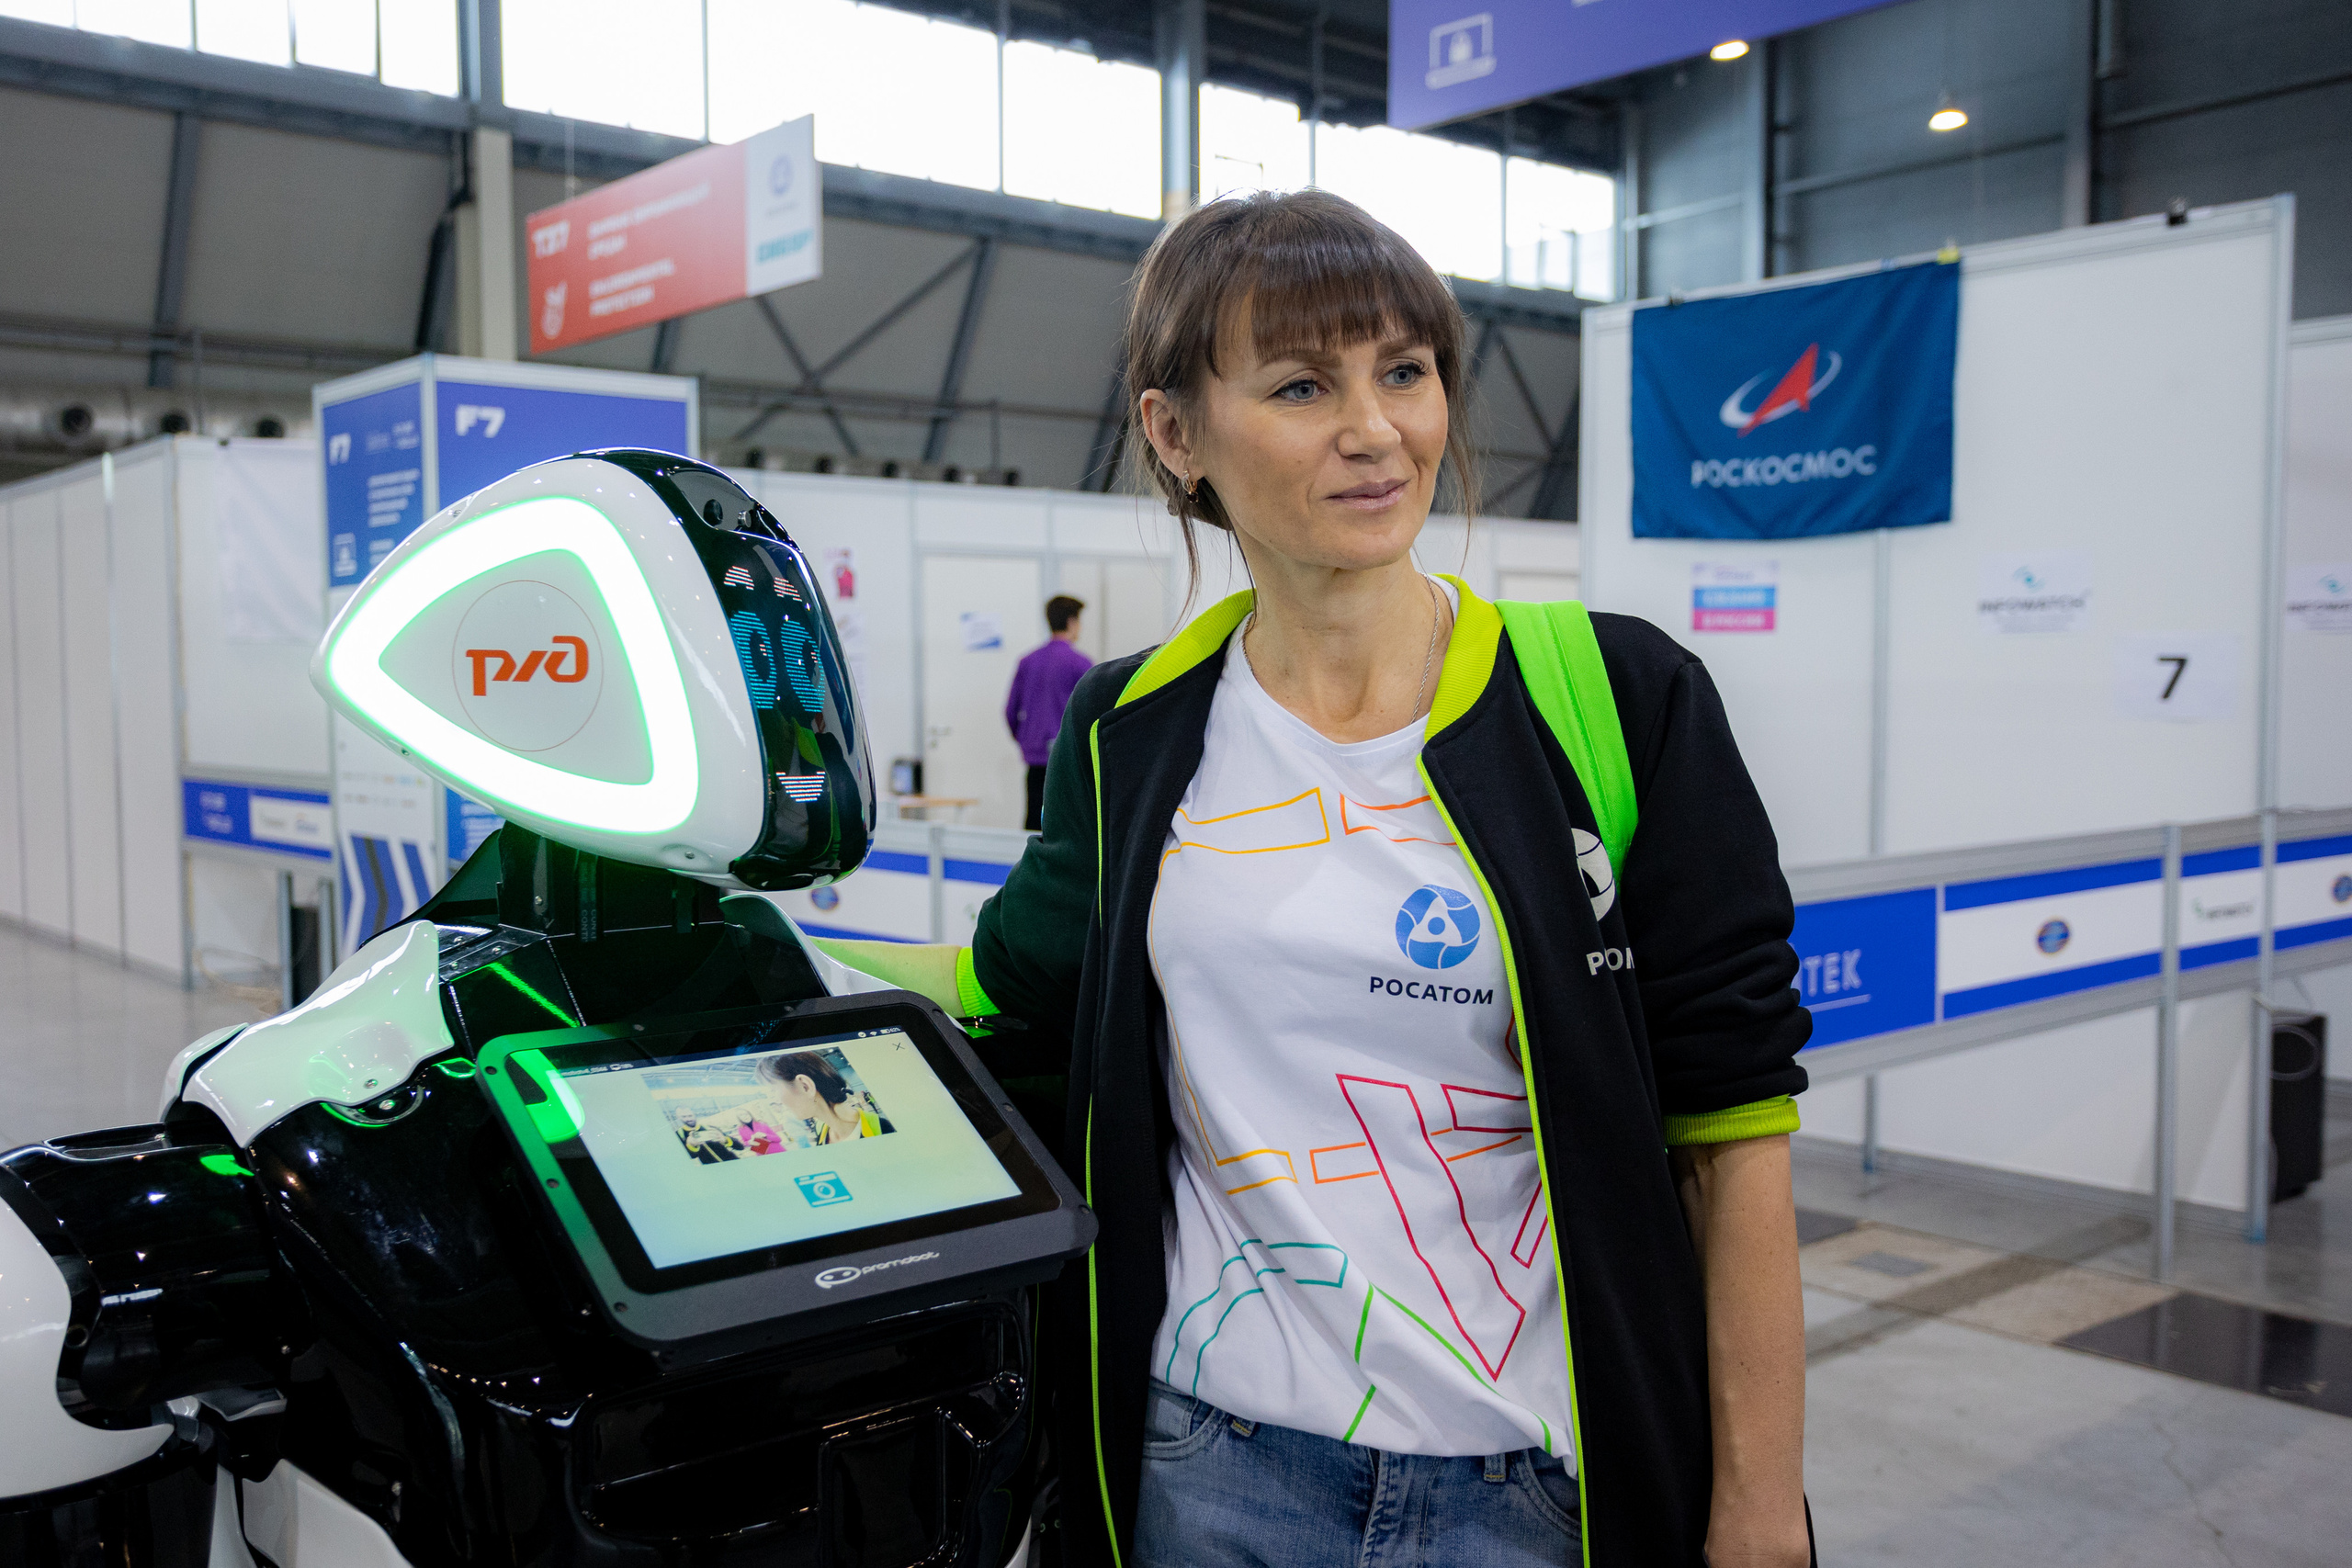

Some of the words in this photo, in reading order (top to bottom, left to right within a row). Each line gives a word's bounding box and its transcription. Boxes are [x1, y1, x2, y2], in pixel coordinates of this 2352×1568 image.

[456, 404, 505, 437] F7
[1691, 445, 1877, 489] РОСКОСМОС
[2158, 656, 2187, 700] 7
[1791, 943, 1862, 998] ТЕК
[1369, 976, 1494, 1005] РОСАТОМ
[862, 1251, 940, 1275] promobot
